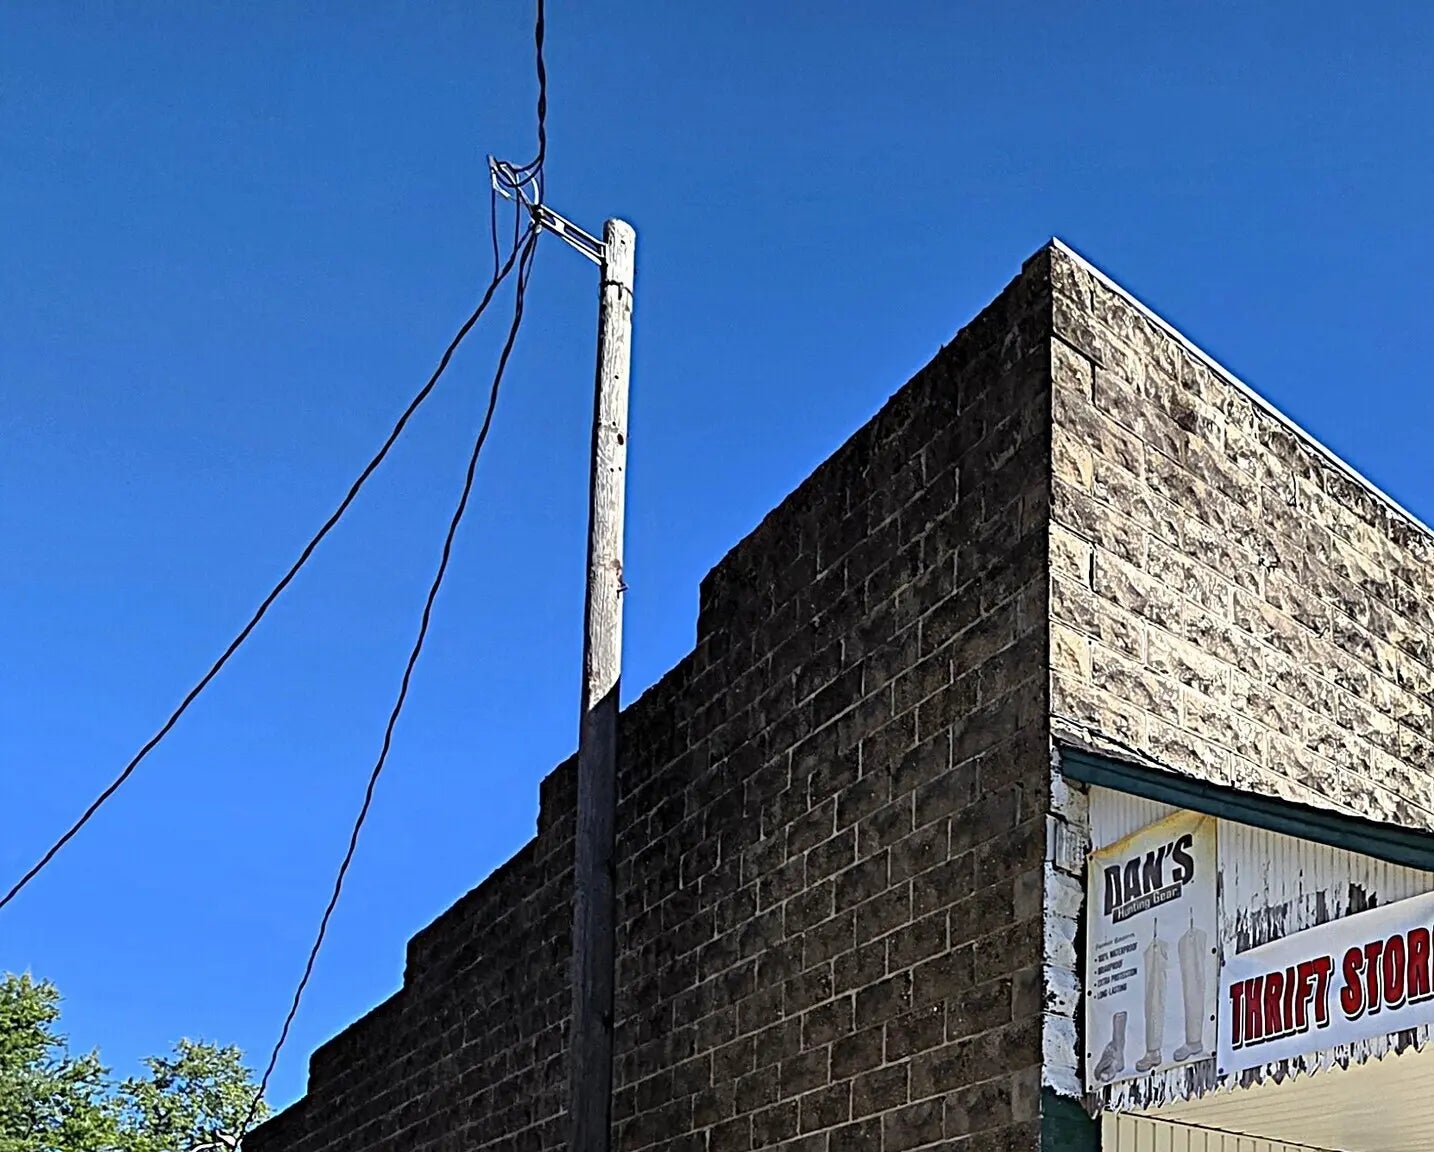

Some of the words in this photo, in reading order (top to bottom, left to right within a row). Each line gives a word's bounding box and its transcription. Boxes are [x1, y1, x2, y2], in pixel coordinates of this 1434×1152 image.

[1103, 833, 1194, 917] DAN'S
[1117, 897, 1151, 920] Hunting
[1229, 954, 1335, 1051] THRIFT
